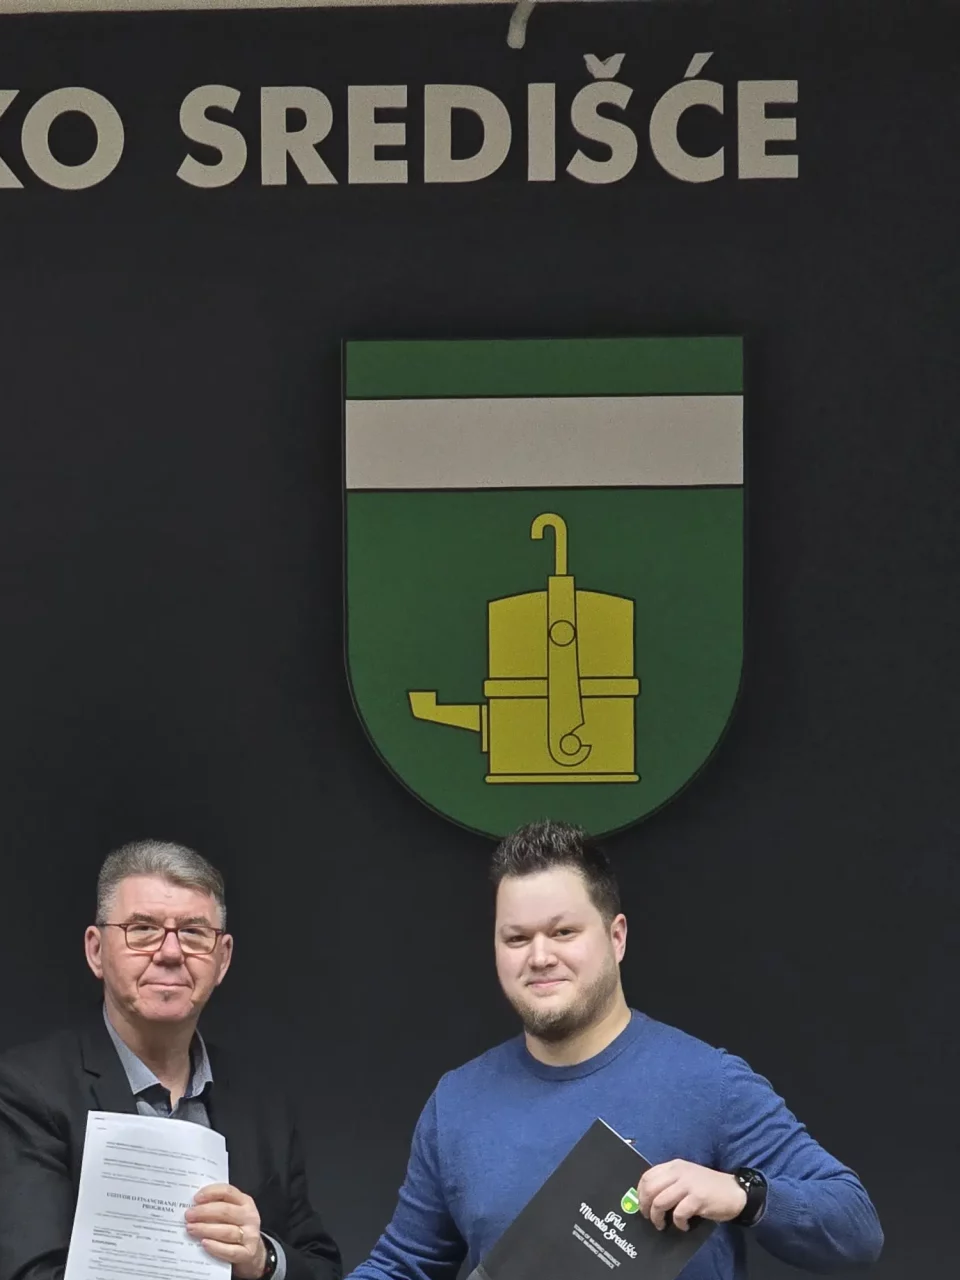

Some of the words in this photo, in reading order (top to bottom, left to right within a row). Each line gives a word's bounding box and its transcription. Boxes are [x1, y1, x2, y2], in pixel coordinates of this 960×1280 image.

[176, 52, 799, 189] SREDIŠĆE
[579, 1202, 608, 1232] Mursko
[604, 1211, 627, 1232] Grad
